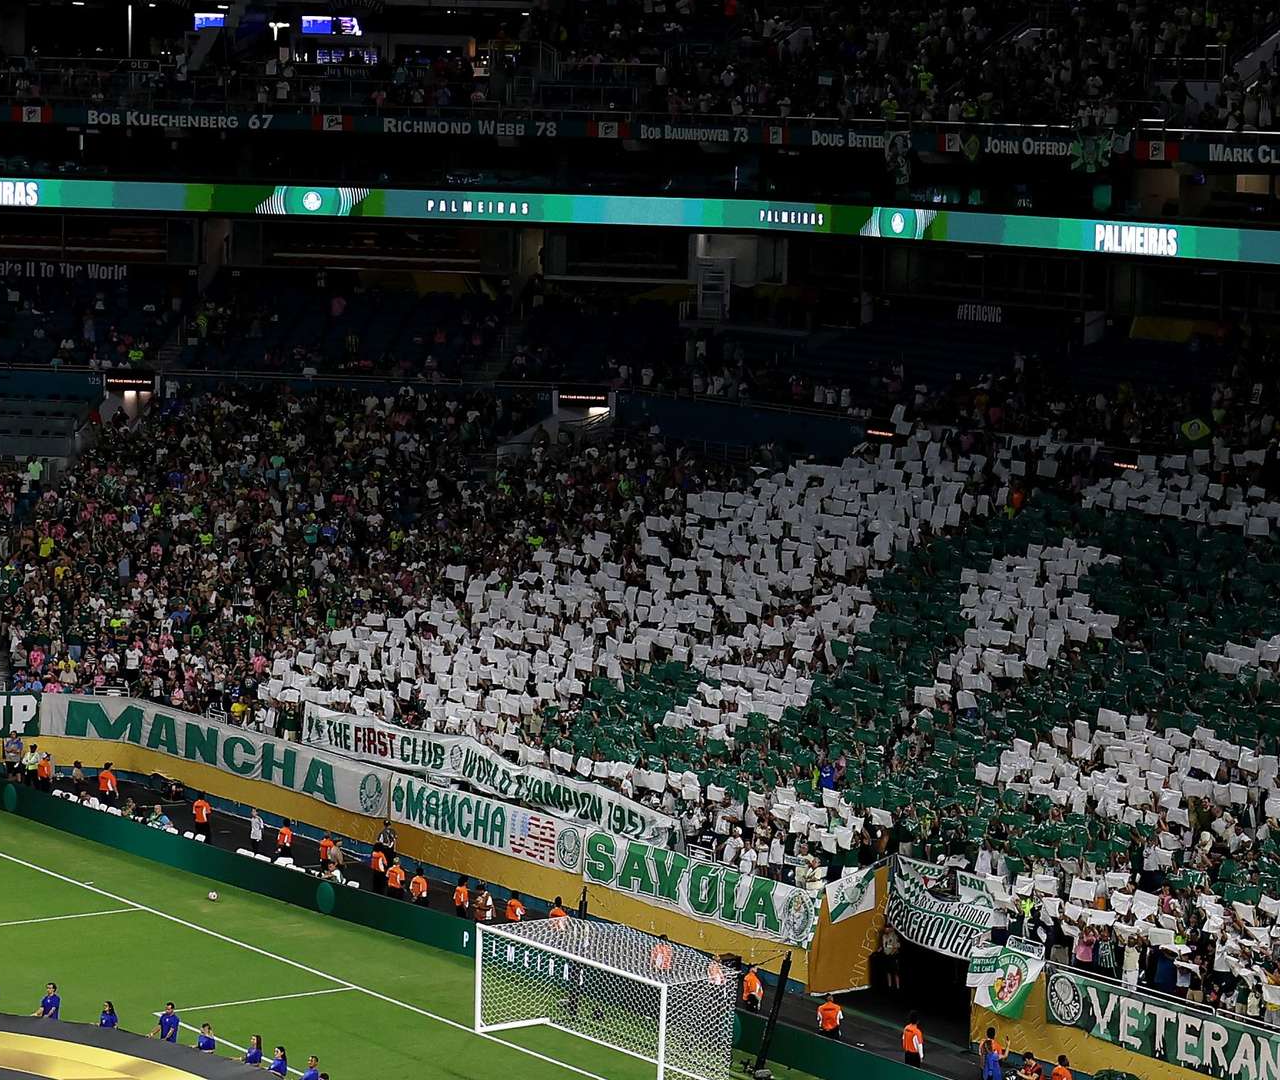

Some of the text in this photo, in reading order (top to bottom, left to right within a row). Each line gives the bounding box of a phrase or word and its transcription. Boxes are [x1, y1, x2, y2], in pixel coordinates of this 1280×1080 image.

[248, 113, 273, 130] 67
[535, 121, 557, 138] 78
[733, 126, 749, 143] 73
[427, 198, 530, 216] PALMEIRAS
[760, 208, 824, 226] PALMEIRAS
[1094, 223, 1178, 258] PALMEIRAS
[956, 303, 1003, 324] #FIFACWC
[66, 700, 338, 805] MANCHA
[326, 720, 352, 751] THE
[354, 728, 397, 758] FIRST
[399, 735, 446, 768] CLUB
[463, 747, 512, 792] WORLD
[515, 775, 605, 823] CHAMPION
[405, 780, 507, 849] MANCHA
[510, 809, 556, 864] USA
[463, 930, 584, 986] PLMEIRAS
